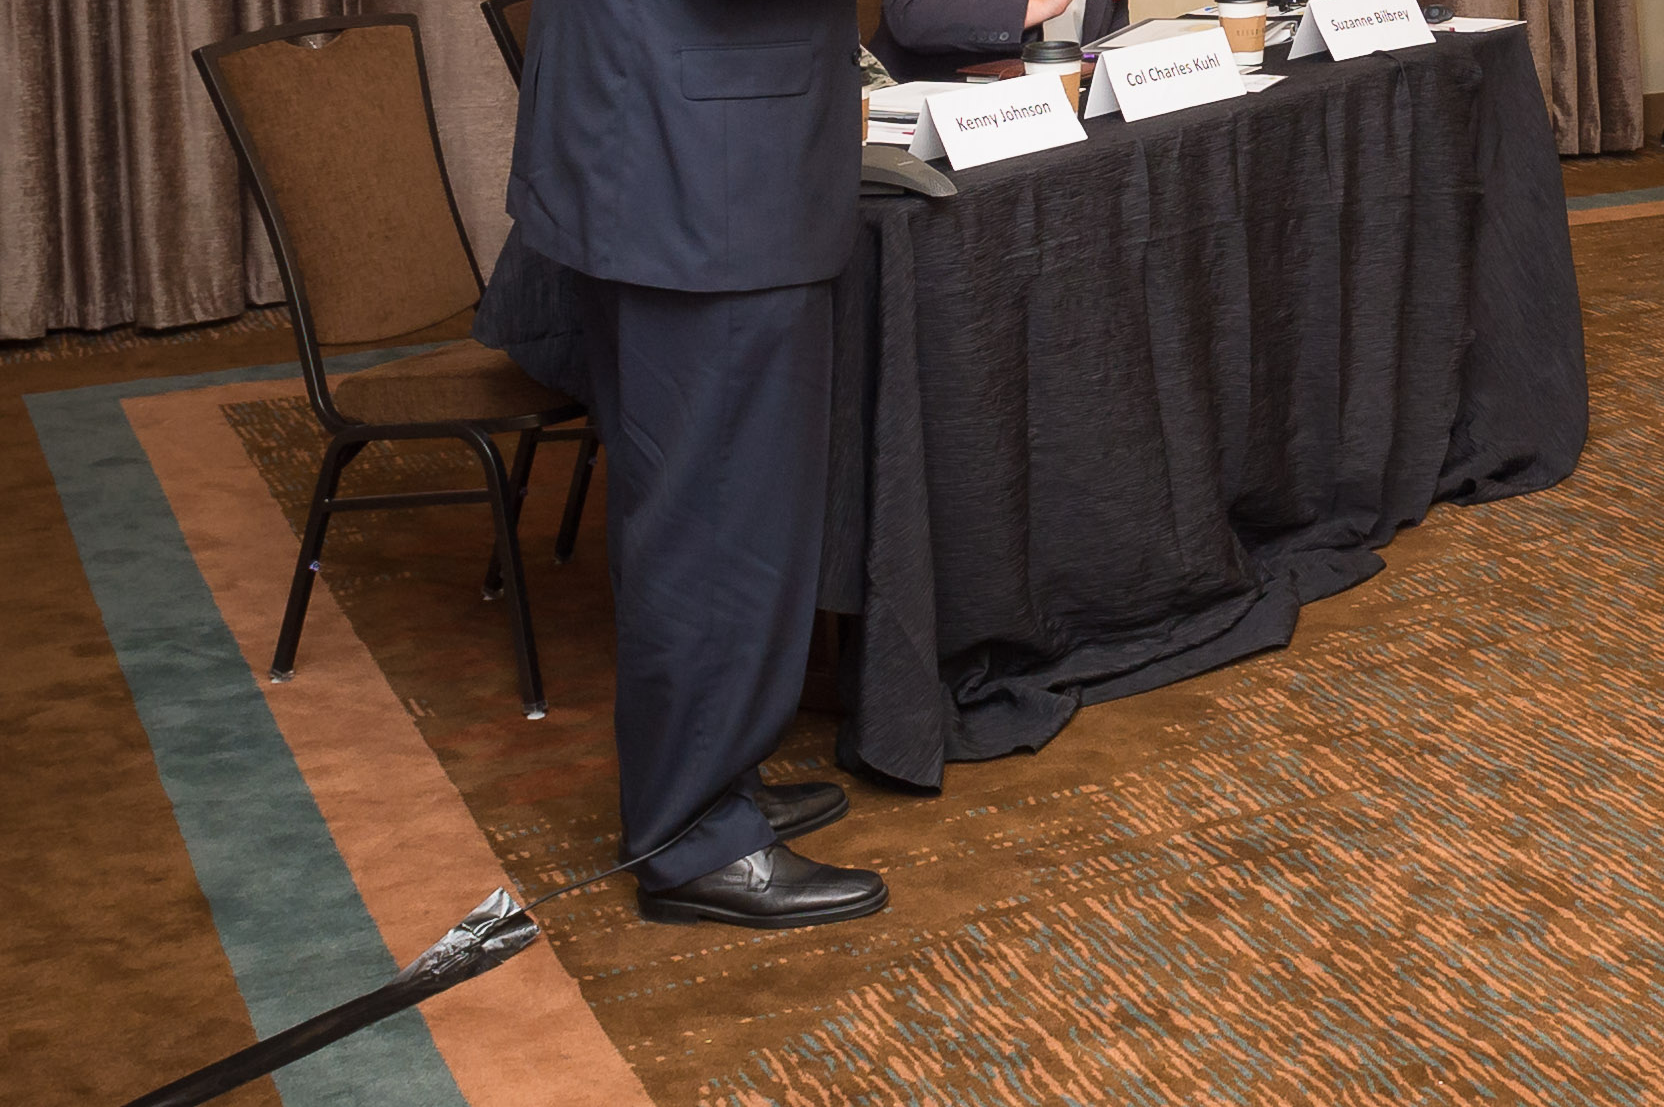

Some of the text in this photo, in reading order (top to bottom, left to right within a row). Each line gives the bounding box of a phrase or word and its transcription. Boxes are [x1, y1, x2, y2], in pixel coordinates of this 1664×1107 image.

[1330, 9, 1410, 32] Suzanne Bilbrey
[1126, 53, 1221, 86] Col Charles Kuhl
[955, 102, 1052, 132] Kenny Johnson
